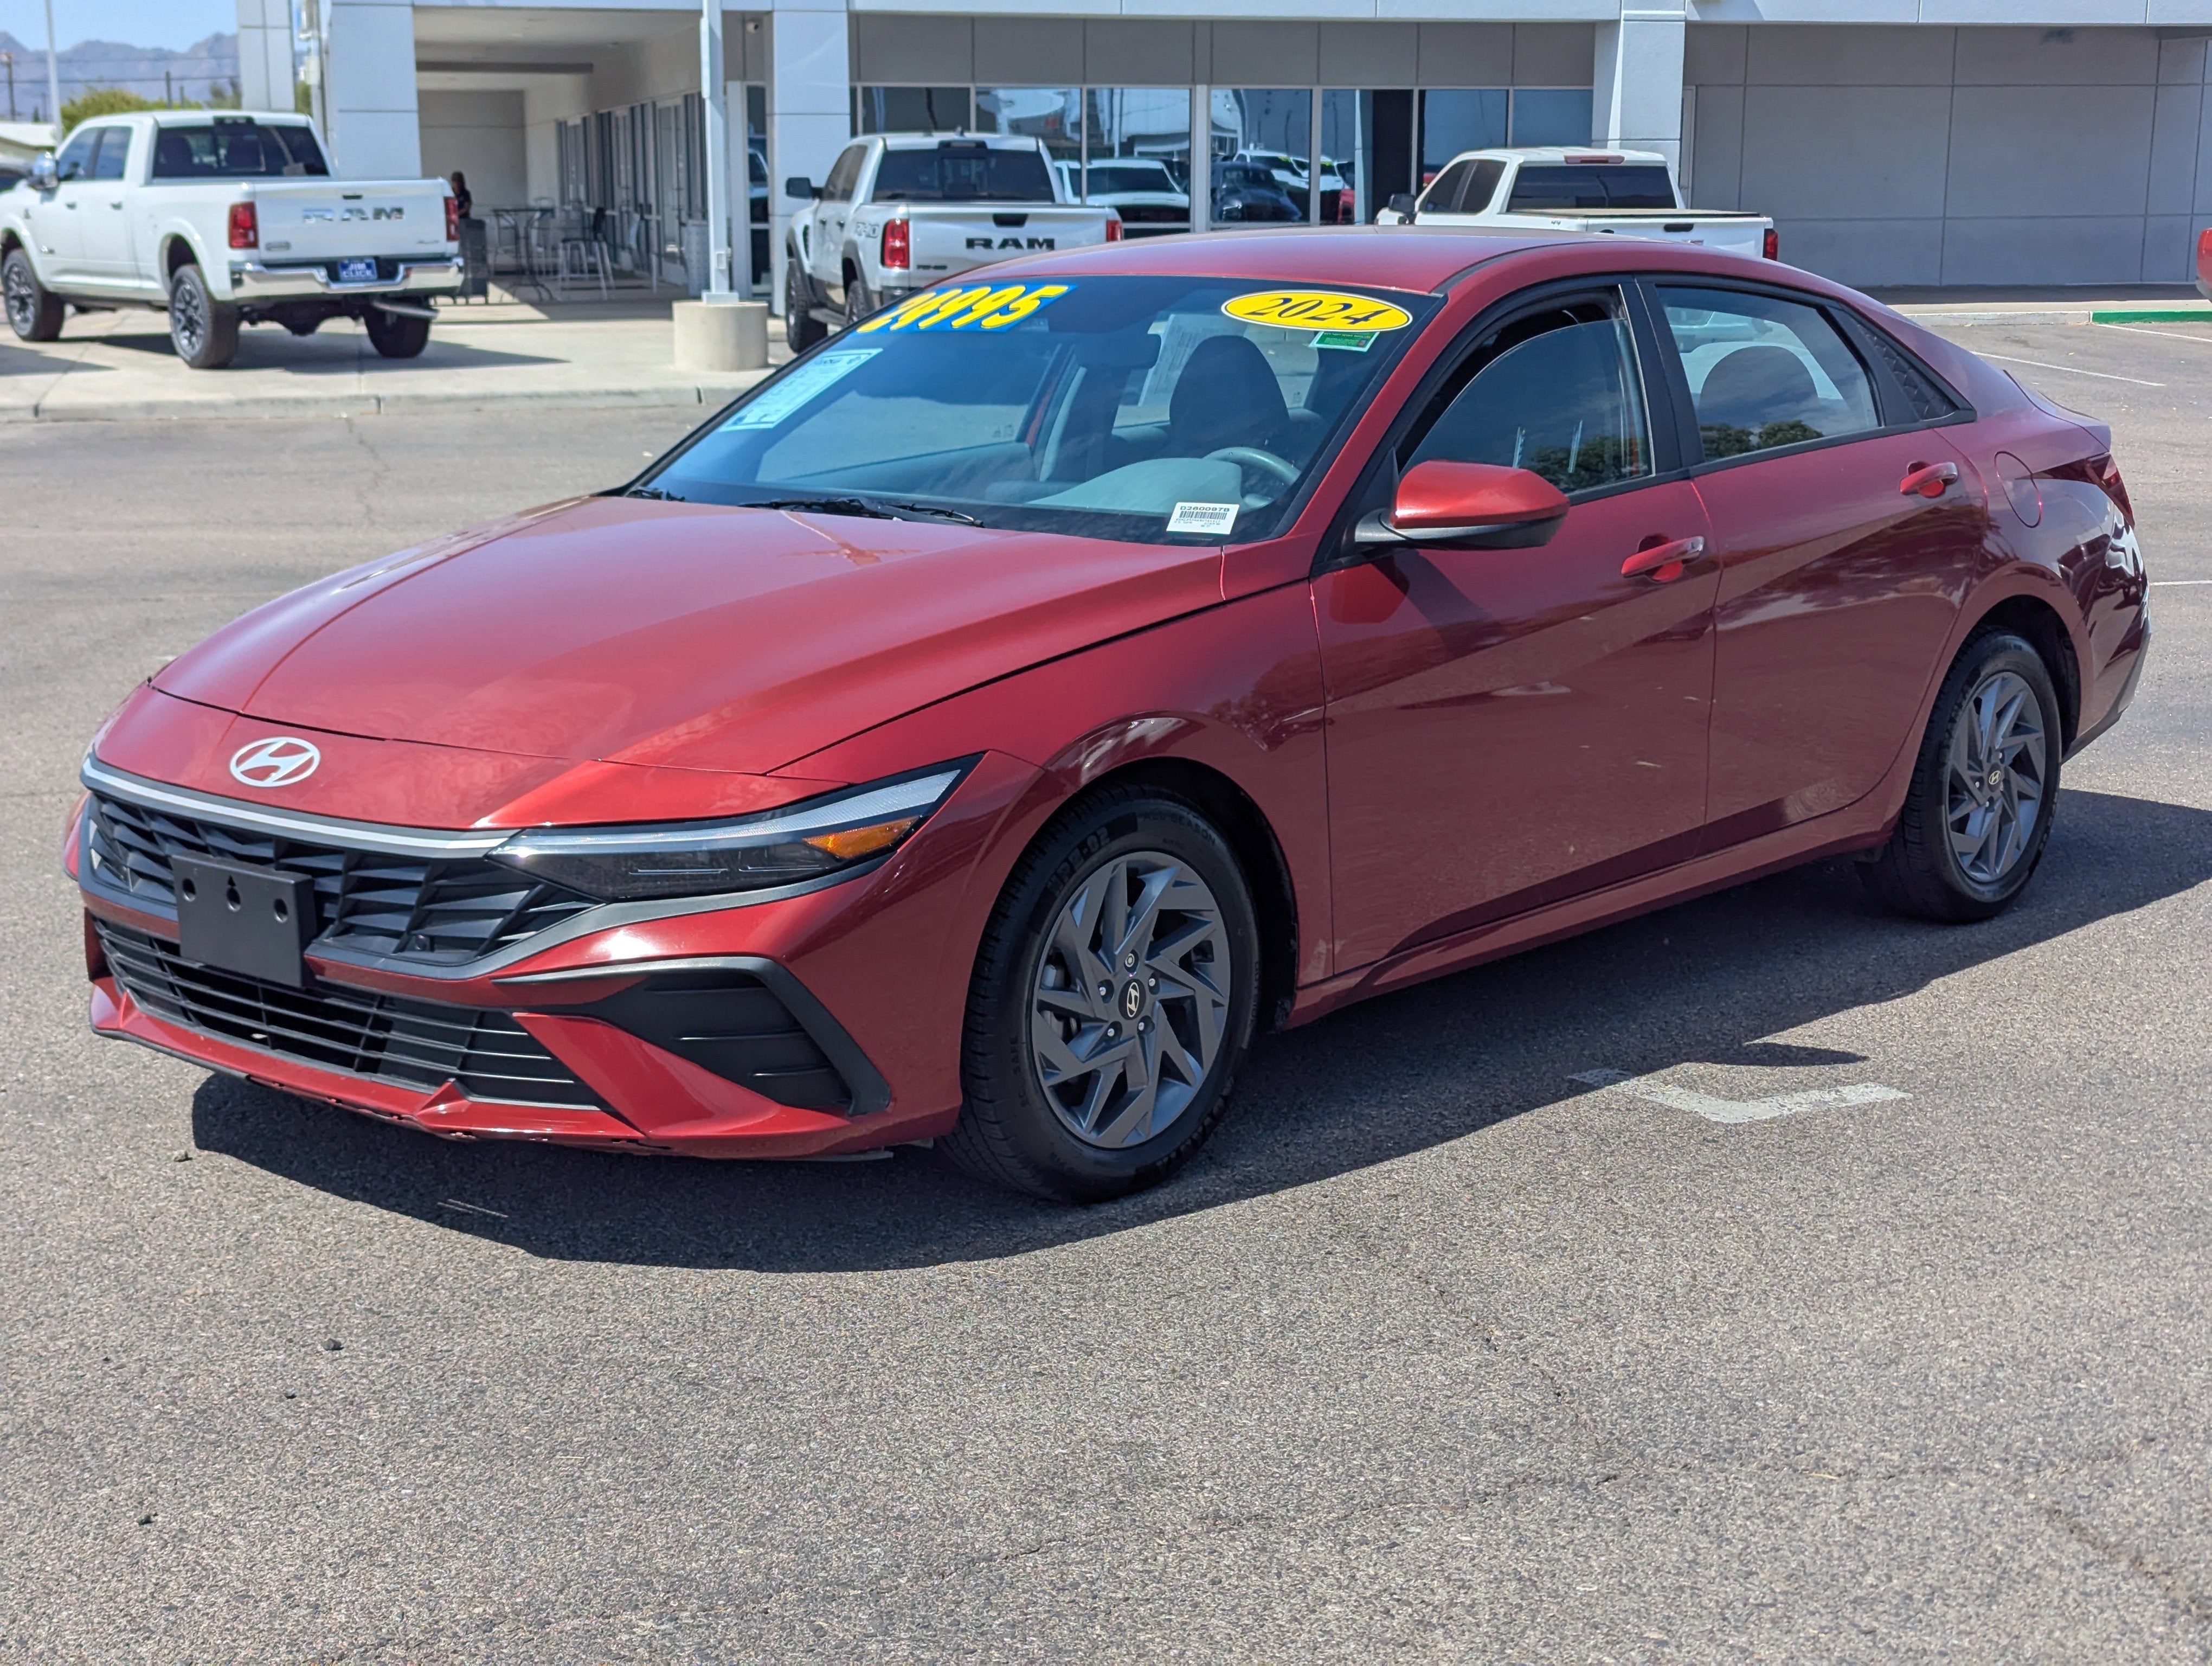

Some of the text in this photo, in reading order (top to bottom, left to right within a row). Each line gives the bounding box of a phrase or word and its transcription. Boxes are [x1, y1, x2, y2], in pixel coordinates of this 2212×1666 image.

[303, 207, 404, 223] RAM
[966, 238, 1055, 250] RAM
[856, 285, 1069, 332] 24995
[1243, 297, 1392, 325] 2024
